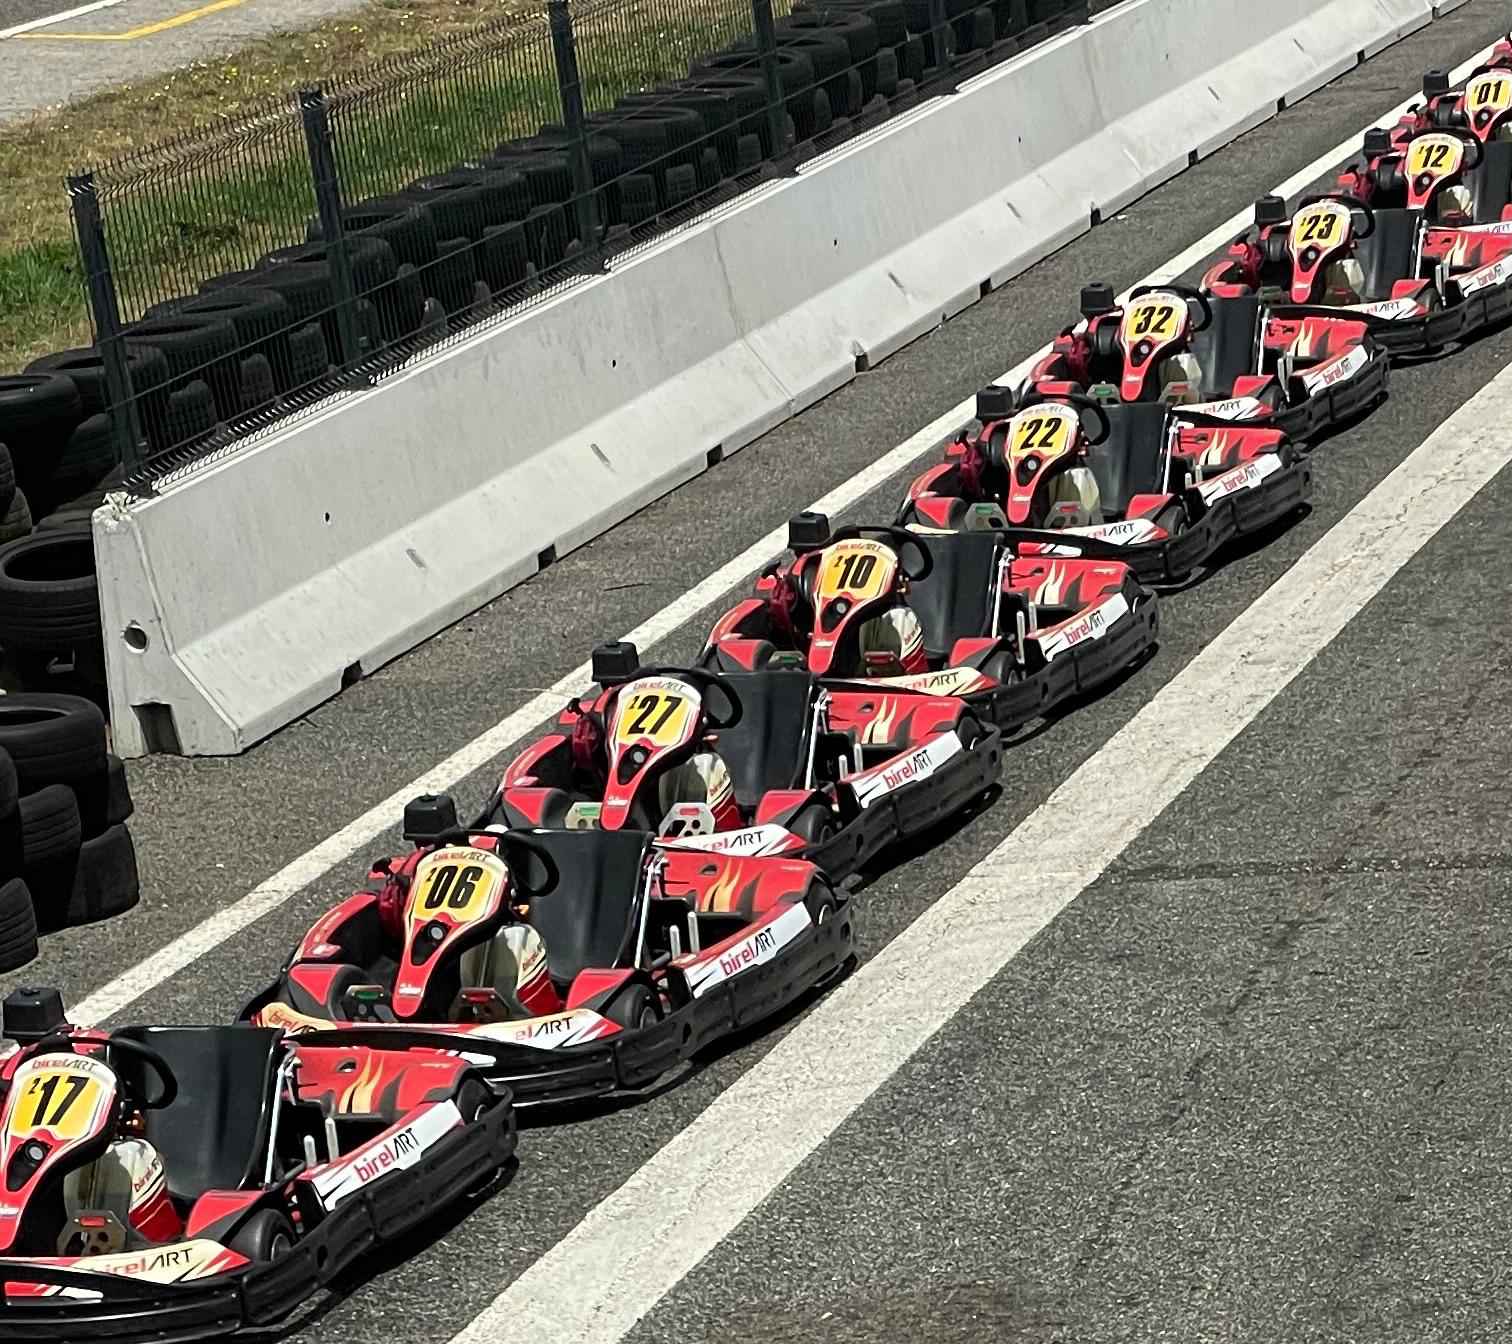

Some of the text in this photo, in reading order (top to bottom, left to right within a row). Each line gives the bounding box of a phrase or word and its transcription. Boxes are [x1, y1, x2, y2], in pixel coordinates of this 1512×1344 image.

[424, 865, 484, 910] 06
[718, 926, 777, 977] birelART
[353, 1127, 421, 1183] birelART
